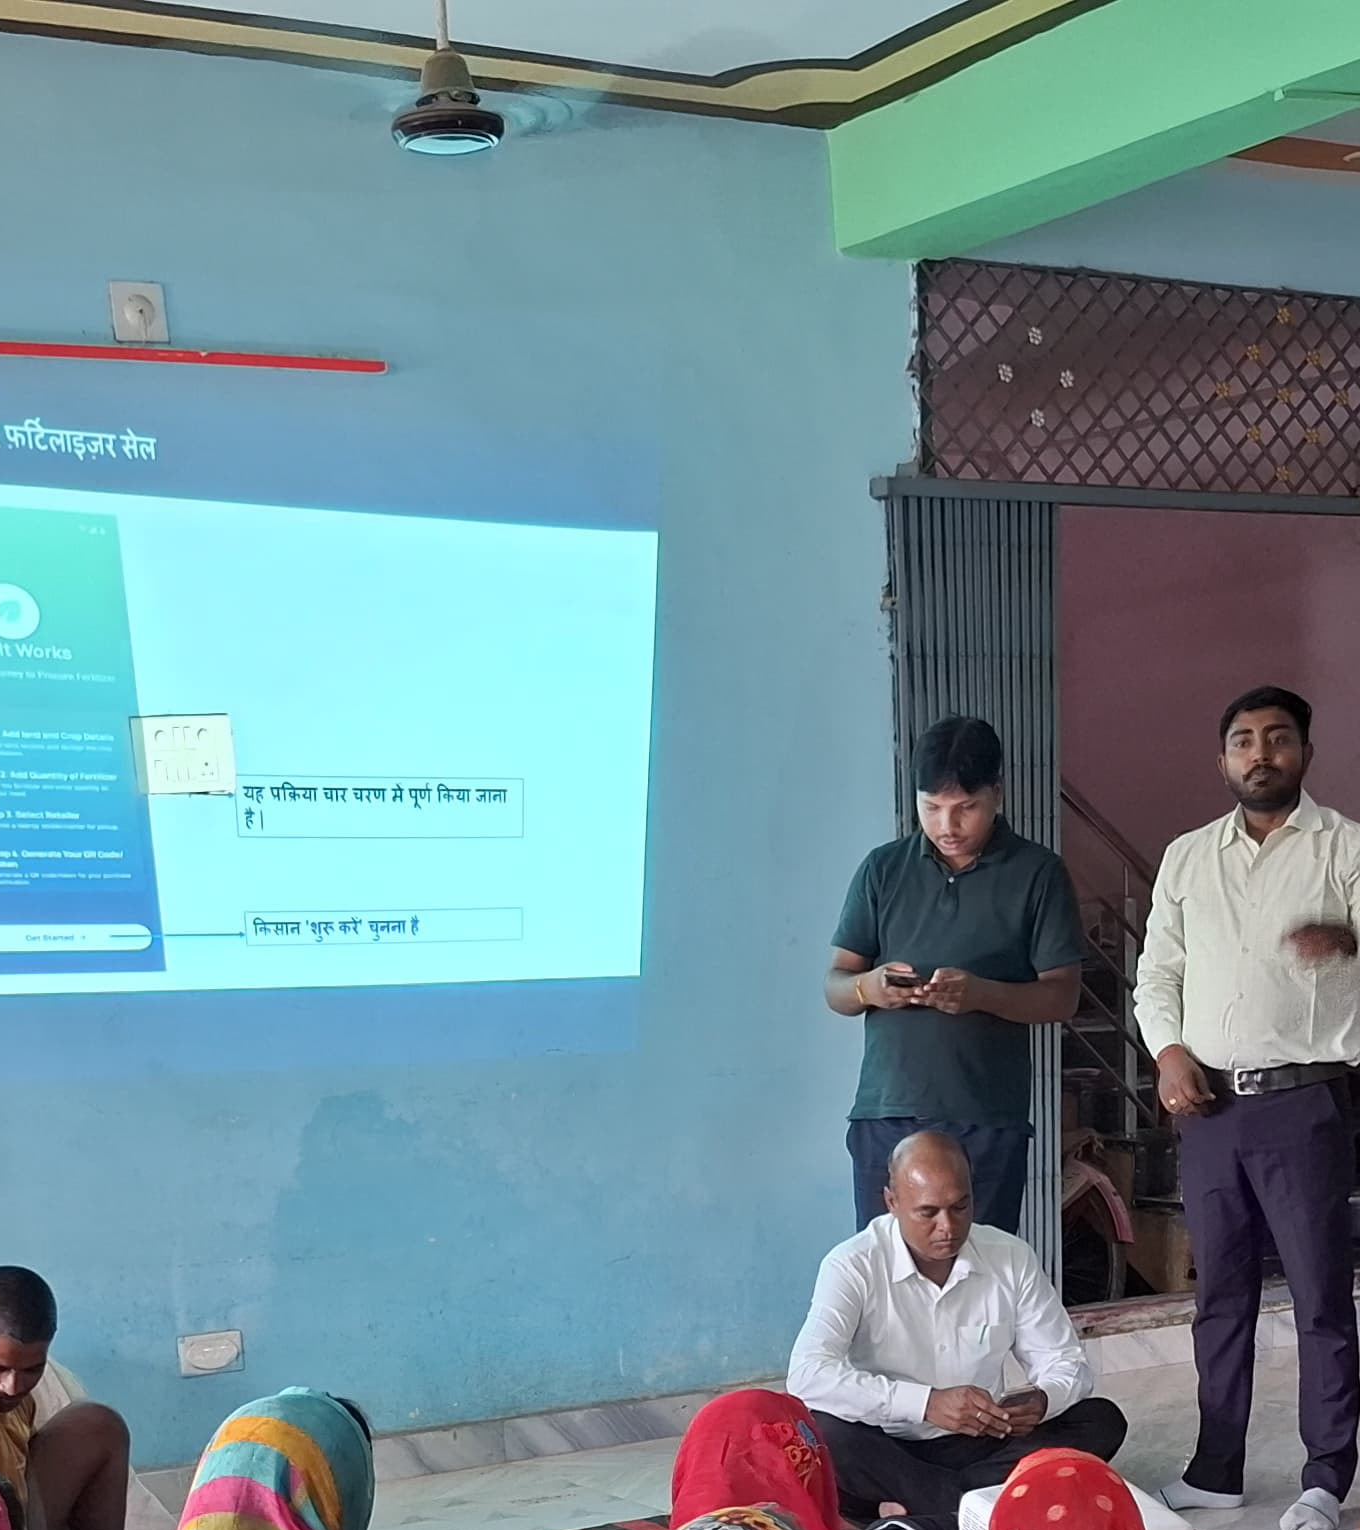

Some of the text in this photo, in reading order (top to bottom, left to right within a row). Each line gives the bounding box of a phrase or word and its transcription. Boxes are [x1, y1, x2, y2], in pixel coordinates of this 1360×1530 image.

[120, 427, 157, 460] सेल
[14, 643, 73, 661] Works
[242, 785, 265, 804] यह
[323, 787, 348, 803] चार
[352, 787, 387, 803] चरण
[408, 782, 433, 810] पूर्ण
[437, 783, 472, 803] किया
[475, 788, 508, 803] जाना
[253, 917, 301, 936] किसान
[368, 920, 407, 941] चुनना
[410, 915, 420, 936] है
